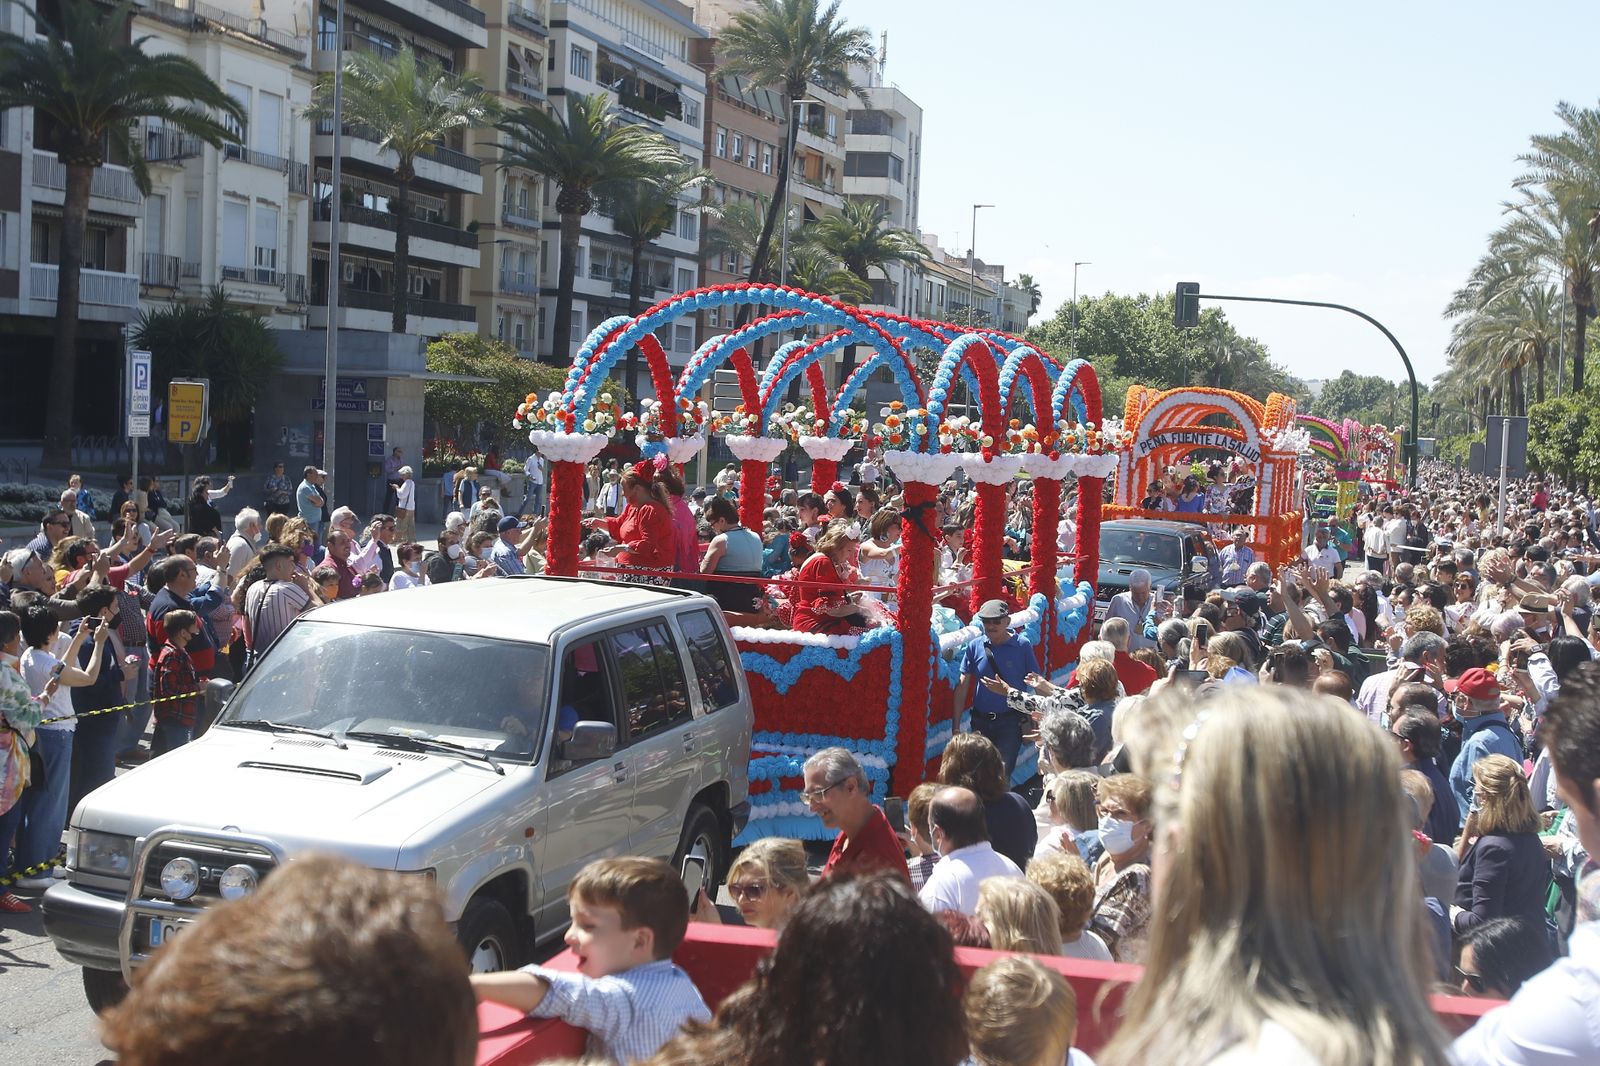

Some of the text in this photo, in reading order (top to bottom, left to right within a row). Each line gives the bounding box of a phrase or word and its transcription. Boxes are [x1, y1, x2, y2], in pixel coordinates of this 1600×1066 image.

[137, 364, 146, 388] P
[180, 421, 192, 438] P
[1171, 432, 1213, 446] FUENTE
